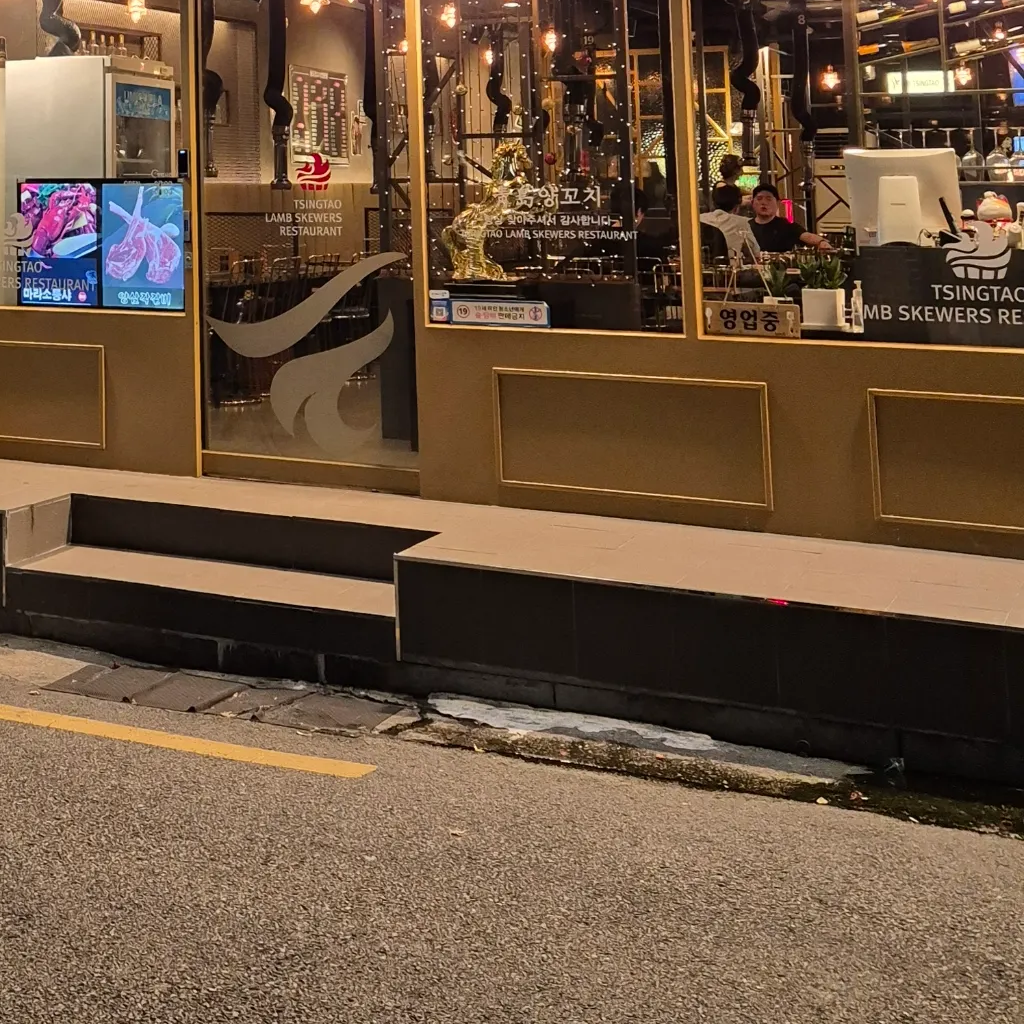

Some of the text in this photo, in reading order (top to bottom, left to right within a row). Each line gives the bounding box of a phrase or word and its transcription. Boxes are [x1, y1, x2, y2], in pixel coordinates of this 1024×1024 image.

[294, 199, 342, 210] TSINGTAO
[265, 212, 342, 223] LAMB SKEWERS
[560, 215, 612, 226] 감사합니다
[280, 226, 343, 236] RESTAURANT
[505, 229, 531, 240] LAMB
[532, 230, 576, 240] SKEWERS
[578, 230, 638, 241] RESTAURANT
[25, 277, 96, 292] RESTAURANT
[459, 307, 468, 315] 19
[898, 305, 991, 324] SKEWERS
[998, 308, 1024, 325] RE
[498, 313, 525, 321] 판매금지
[719, 308, 780, 332] 영업중
